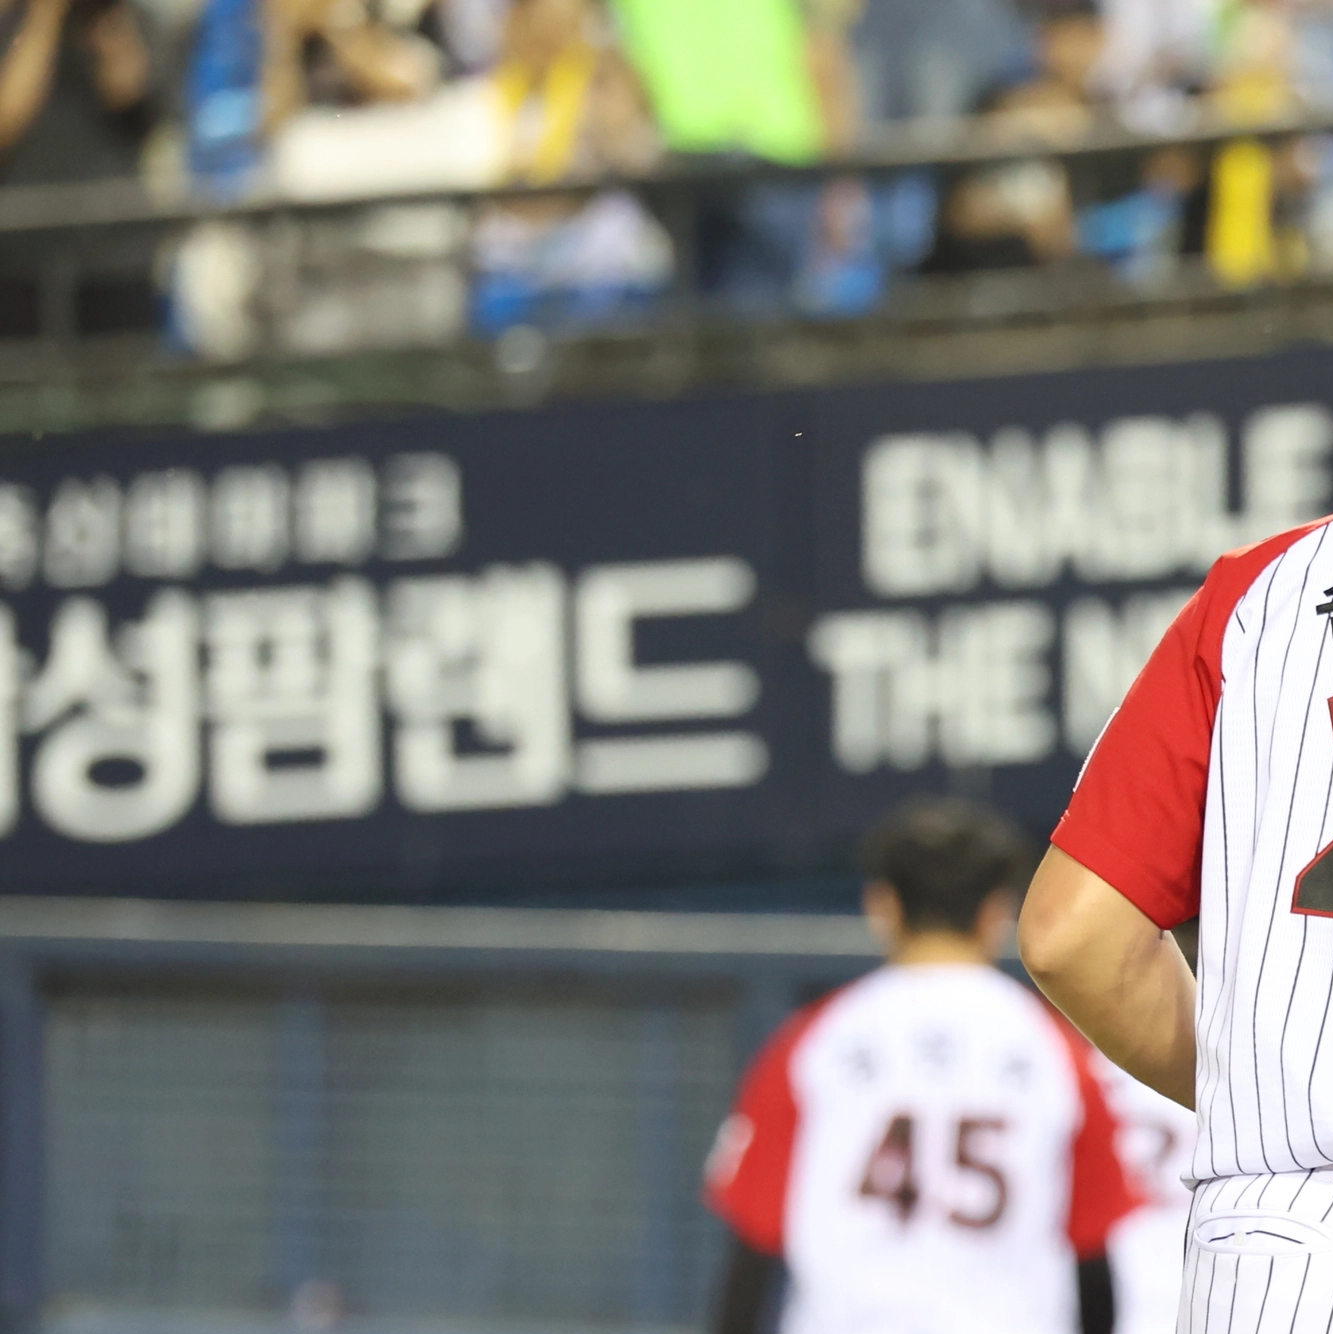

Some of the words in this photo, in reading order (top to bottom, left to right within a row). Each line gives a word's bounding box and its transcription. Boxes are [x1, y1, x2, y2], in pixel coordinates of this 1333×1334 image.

[0, 556, 770, 844] 성팜랜드
[808, 606, 1058, 775] THE
[852, 1107, 1012, 1230] 45
